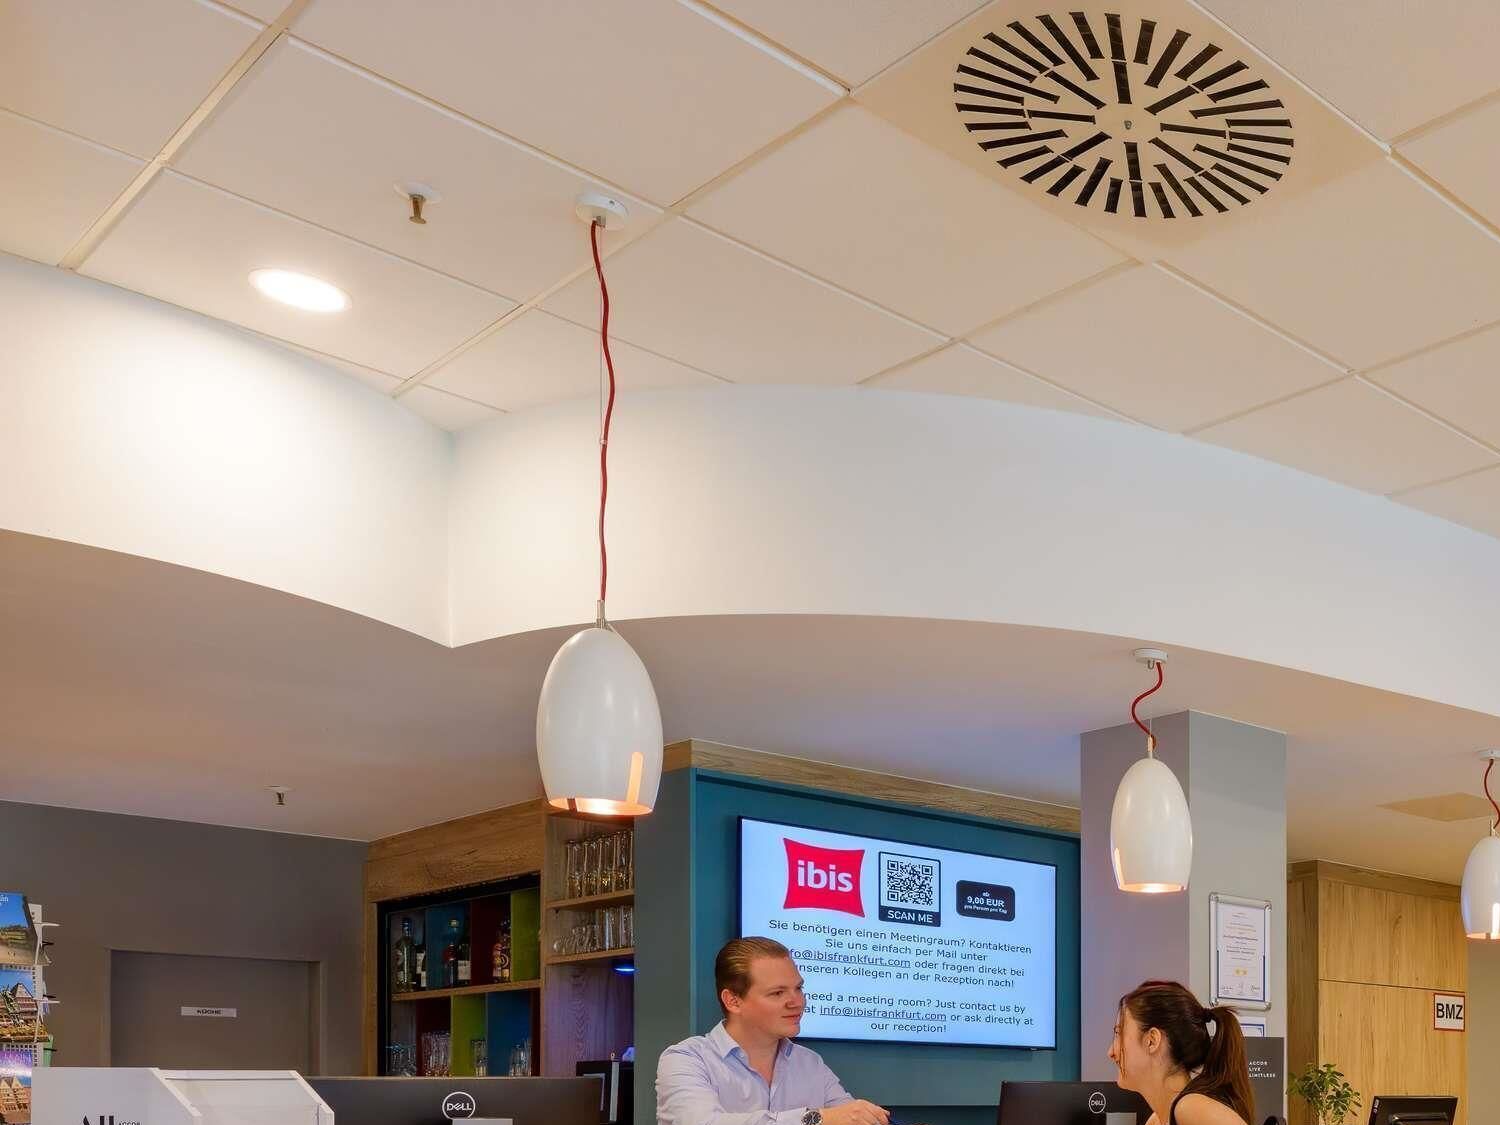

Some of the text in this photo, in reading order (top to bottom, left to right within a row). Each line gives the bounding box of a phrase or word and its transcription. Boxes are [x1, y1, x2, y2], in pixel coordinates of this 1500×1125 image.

[797, 860, 853, 893] ibis
[986, 898, 1005, 908] EUR
[887, 910, 933, 923] SCAN ME
[769, 919, 1032, 954] Sie benötigen einen Meetingraum? Kontaktieren
[825, 938, 988, 961] Sie uns einfach per Mail unter
[789, 948, 1025, 977] fo@ibisfrankfurt.com oder fragen direkt bei
[843, 966, 892, 979] Kollegen
[895, 971, 909, 980] an
[912, 971, 931, 981] der
[934, 973, 985, 986] Rezeption
[987, 978, 1014, 988] nach!
[804, 992, 1026, 1015] need a meeting room? Just contact us by
[1436, 1002, 1463, 1020] BMZ
[804, 1005, 1035, 1026] at info@ibisfrankfurt.com or ask directly at
[870, 1022, 947, 1033] our reception!
[446, 1102, 472, 1111] DELL
